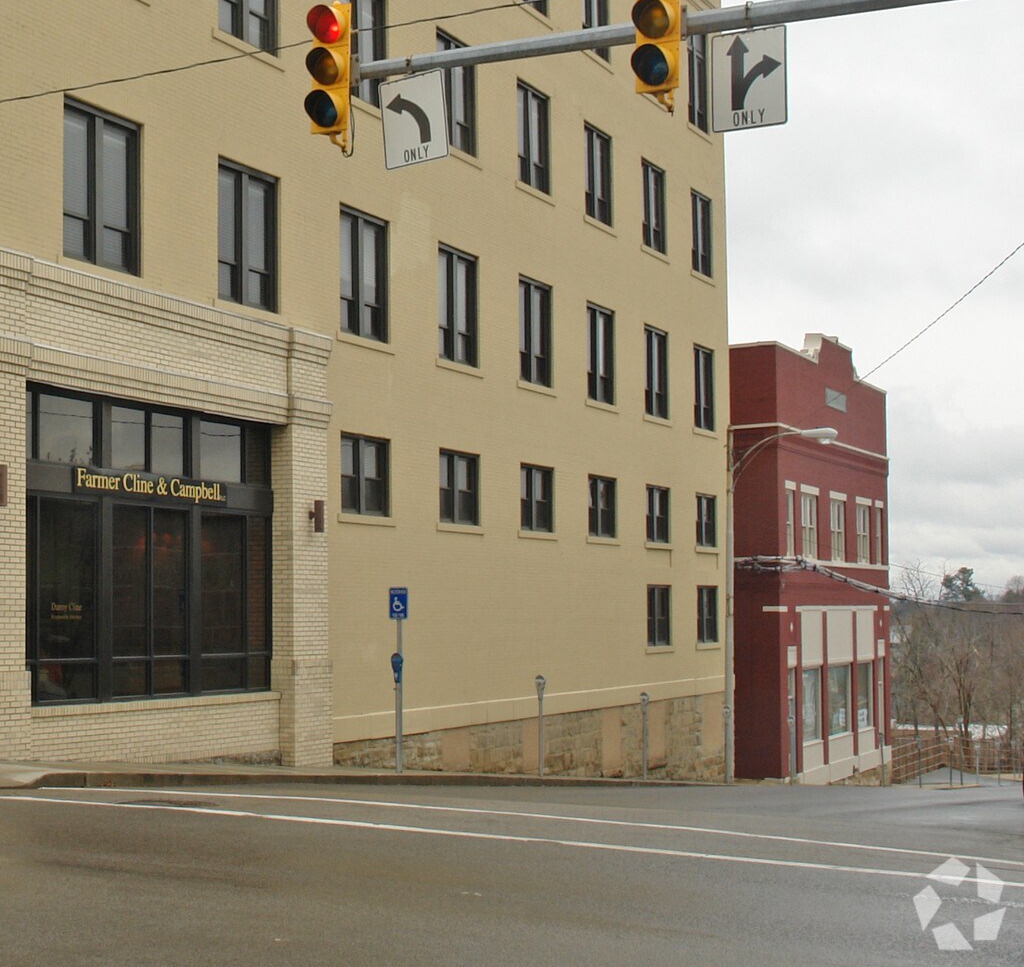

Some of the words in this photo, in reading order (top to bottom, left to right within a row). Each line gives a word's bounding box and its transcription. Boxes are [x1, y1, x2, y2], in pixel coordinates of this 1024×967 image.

[733, 108, 765, 127] ONLY
[403, 144, 429, 163] ONLY
[77, 467, 120, 491] Farmer
[123, 473, 154, 494] Cline
[156, 477, 168, 496] &
[170, 479, 222, 504] Campbell
